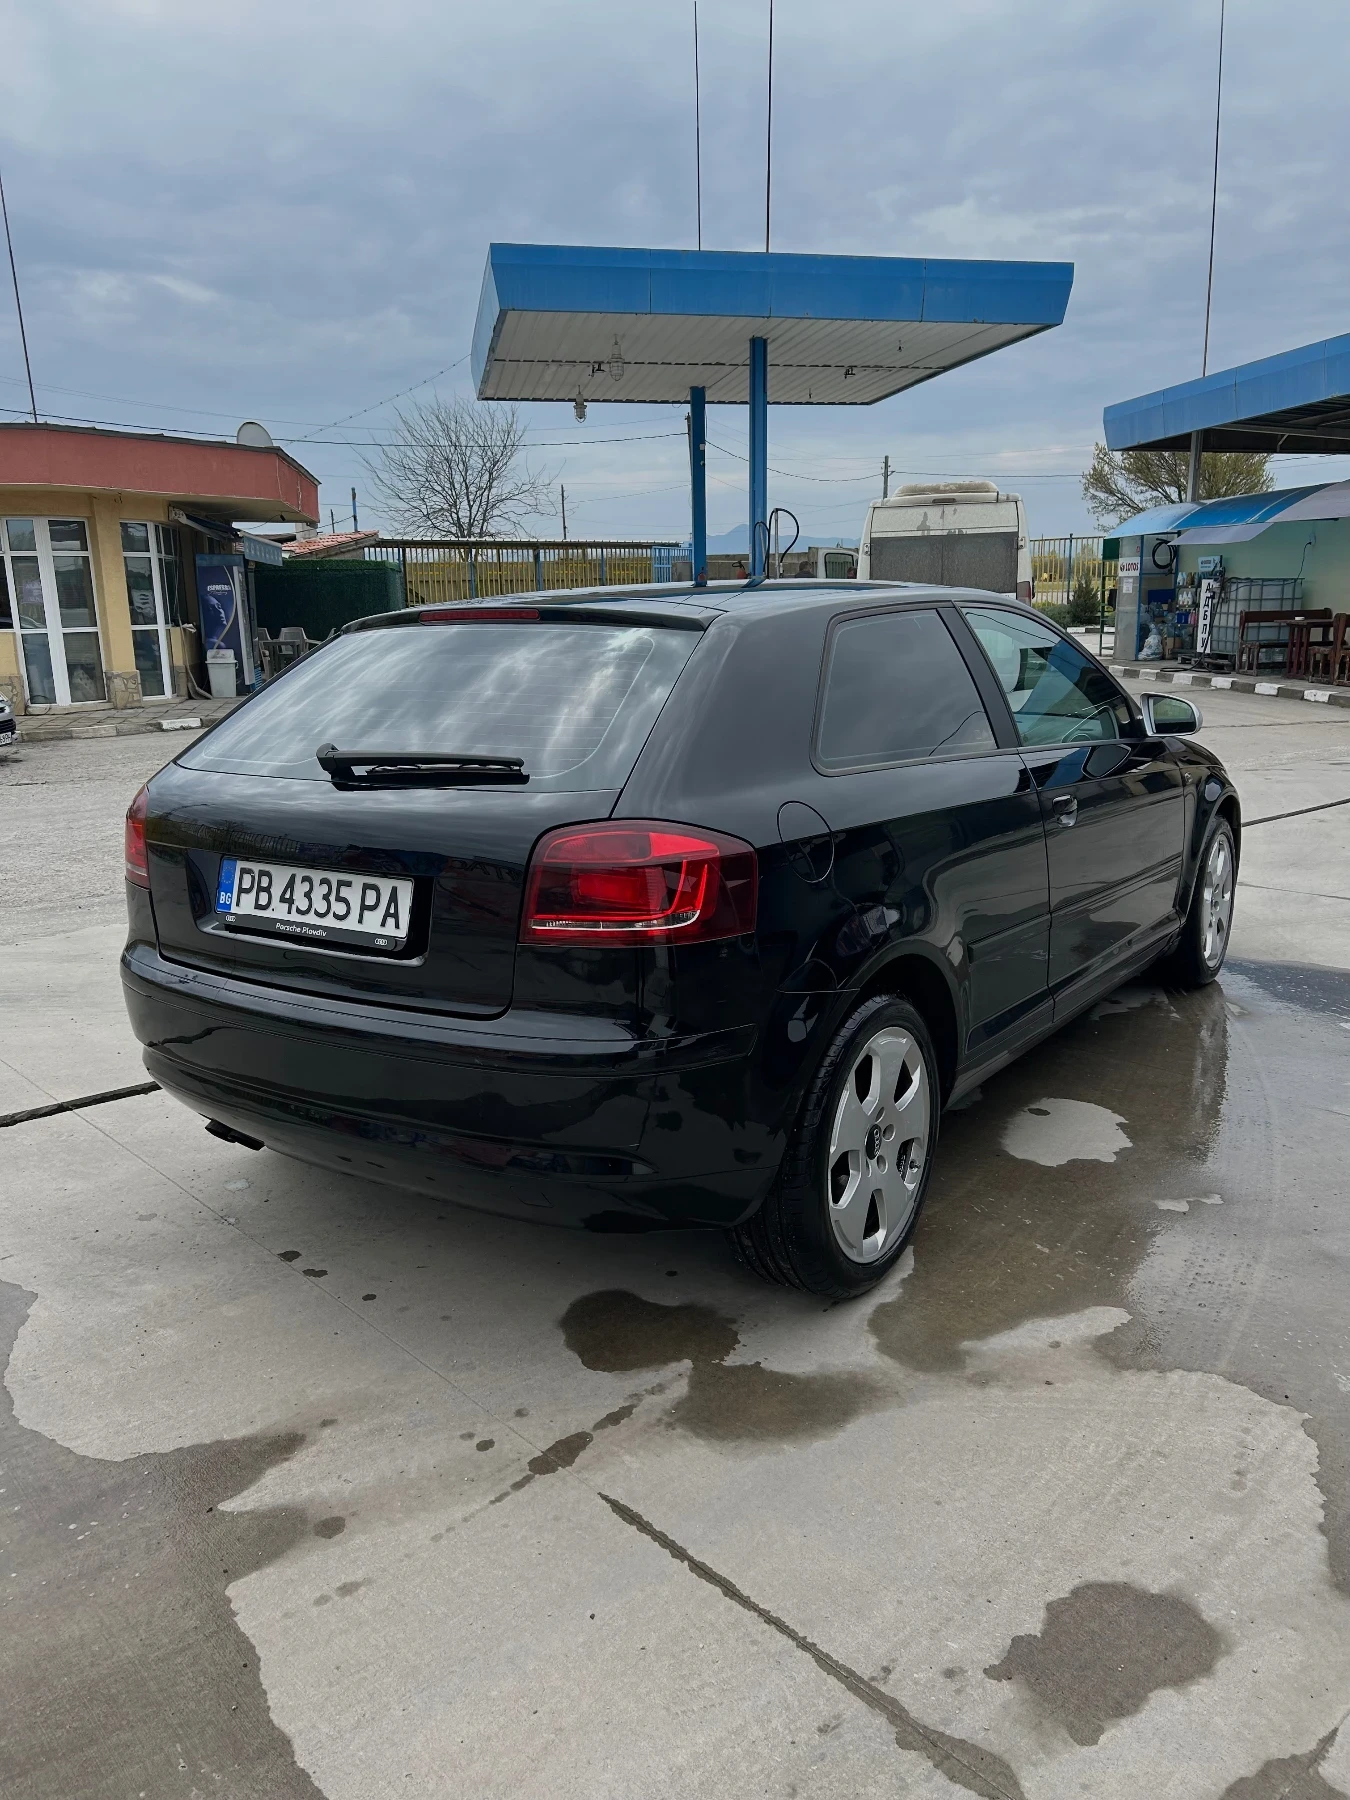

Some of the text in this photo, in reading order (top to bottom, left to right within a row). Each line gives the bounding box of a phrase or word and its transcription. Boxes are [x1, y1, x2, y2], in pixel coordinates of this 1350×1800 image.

[219, 891, 232, 905] BG
[275, 922, 327, 937] Porsche Plovdiv
